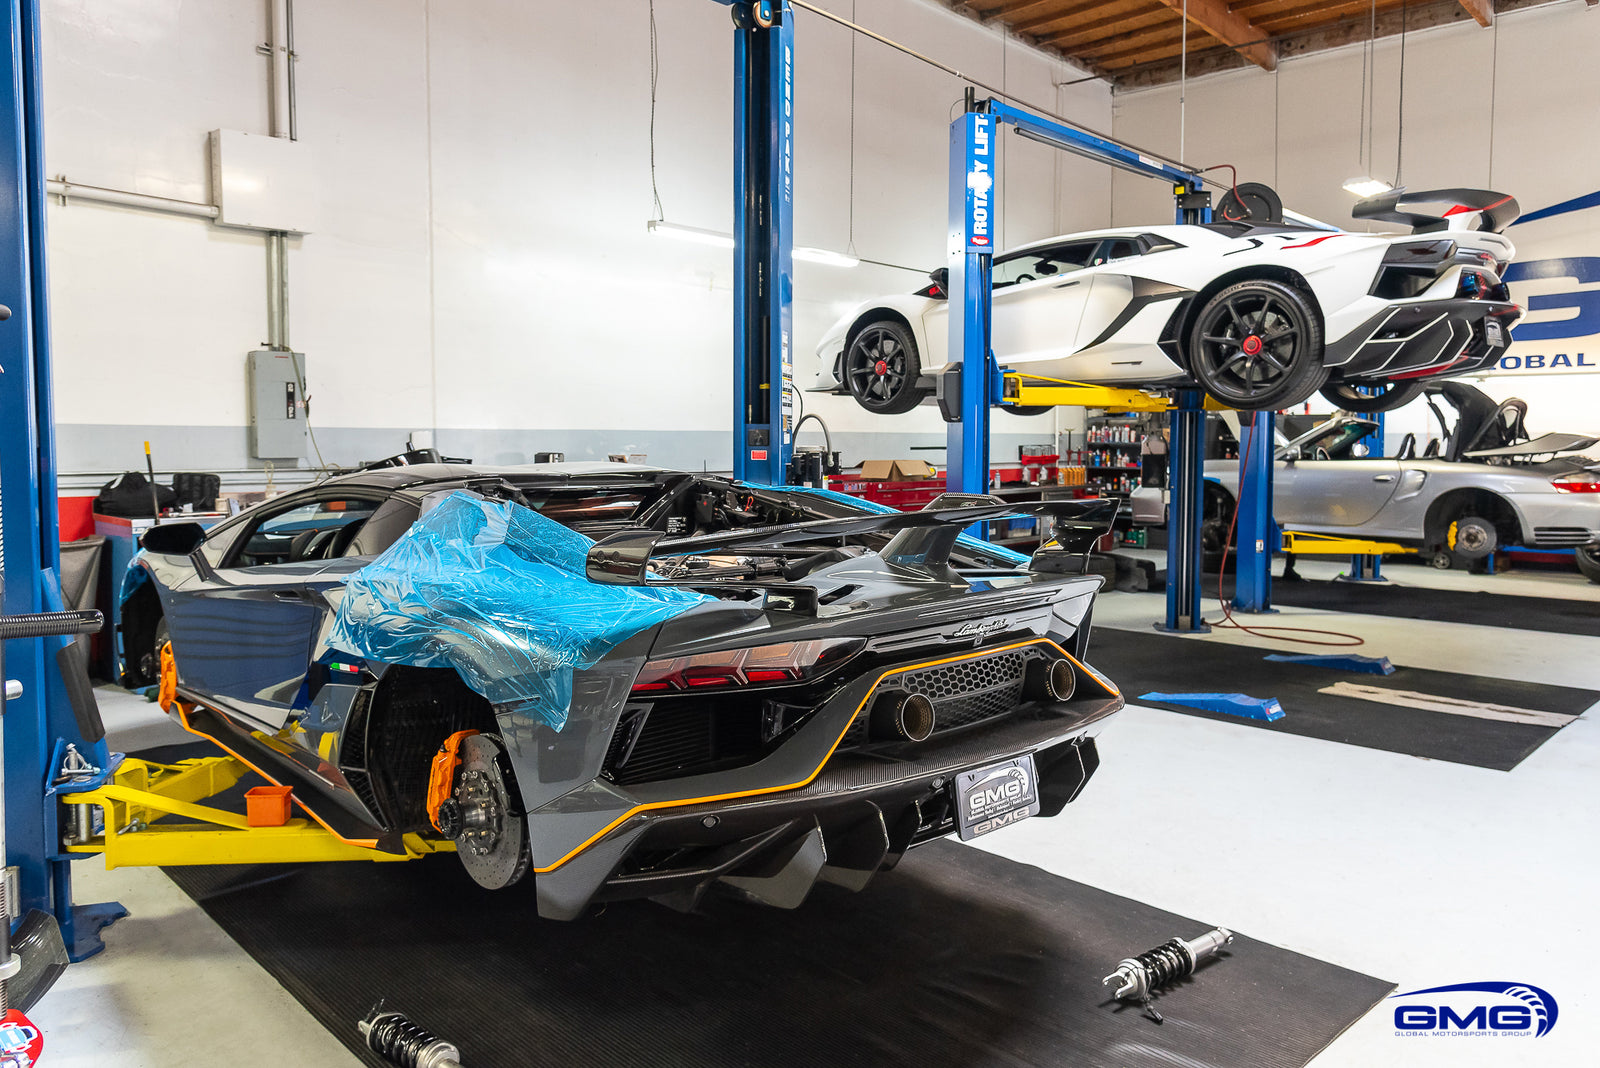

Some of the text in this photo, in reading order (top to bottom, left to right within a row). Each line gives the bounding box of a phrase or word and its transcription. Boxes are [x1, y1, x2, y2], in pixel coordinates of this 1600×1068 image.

[974, 115, 989, 156] LIFT
[973, 160, 988, 235] ROTAY
[1490, 353, 1596, 371] OBAL
[969, 780, 1021, 810] GMG
[973, 806, 1030, 835] GMG
